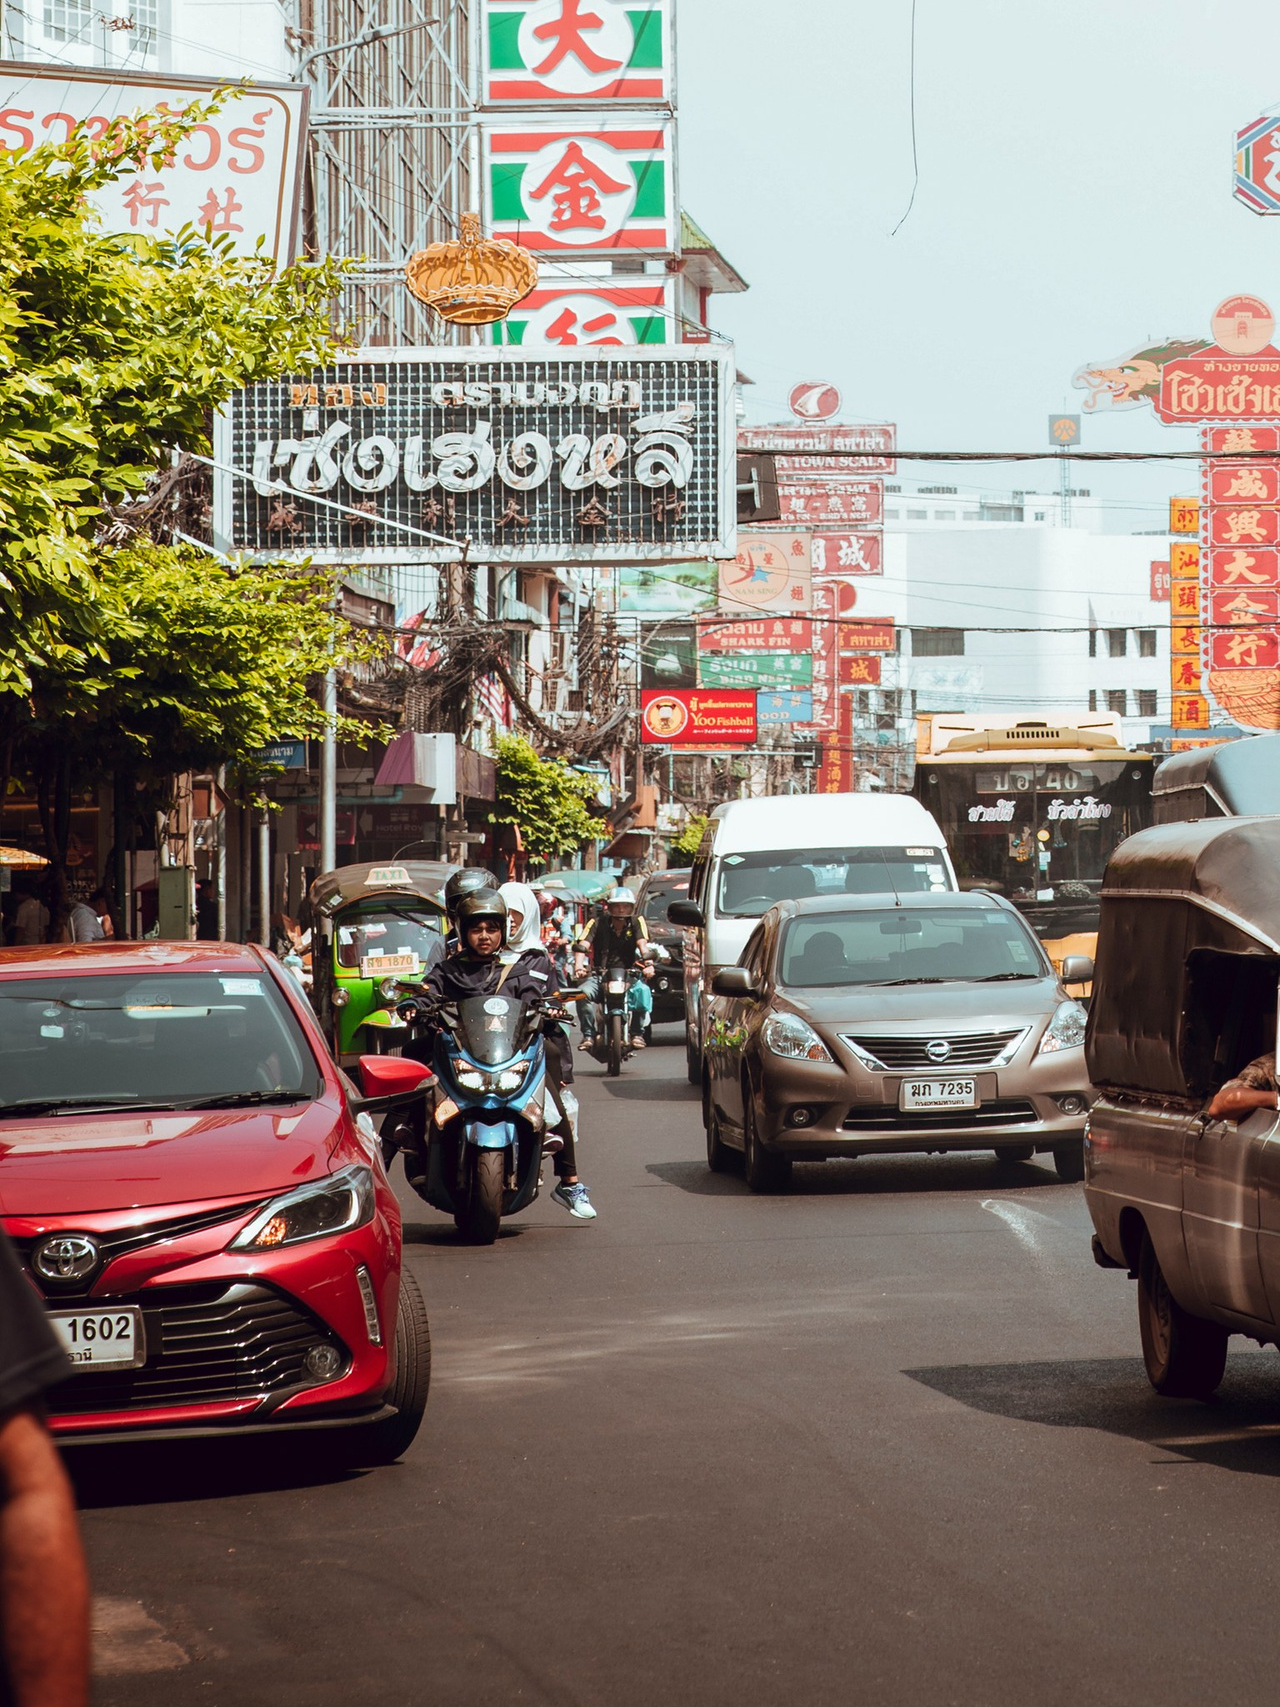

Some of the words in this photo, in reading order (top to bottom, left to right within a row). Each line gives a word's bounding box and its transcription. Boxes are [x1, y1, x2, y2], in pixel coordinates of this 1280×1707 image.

[288, 383, 388, 408] ทอง
[838, 455, 887, 468] SCALA
[757, 587, 778, 595] SING
[720, 636, 766, 647] SHARK
[769, 637, 791, 646] FIN
[719, 674, 754, 685] BIRD
[757, 673, 792, 684] NEST
[716, 716, 754, 726] Fishball
[1047, 795, 1113, 821] หัวลำโพง
[375, 824, 402, 833] Hotel
[373, 869, 403, 881] TAXI
[387, 955, 413, 967] 1870
[938, 1081, 973, 1096] 7235
[67, 1314, 131, 1343] 1602
